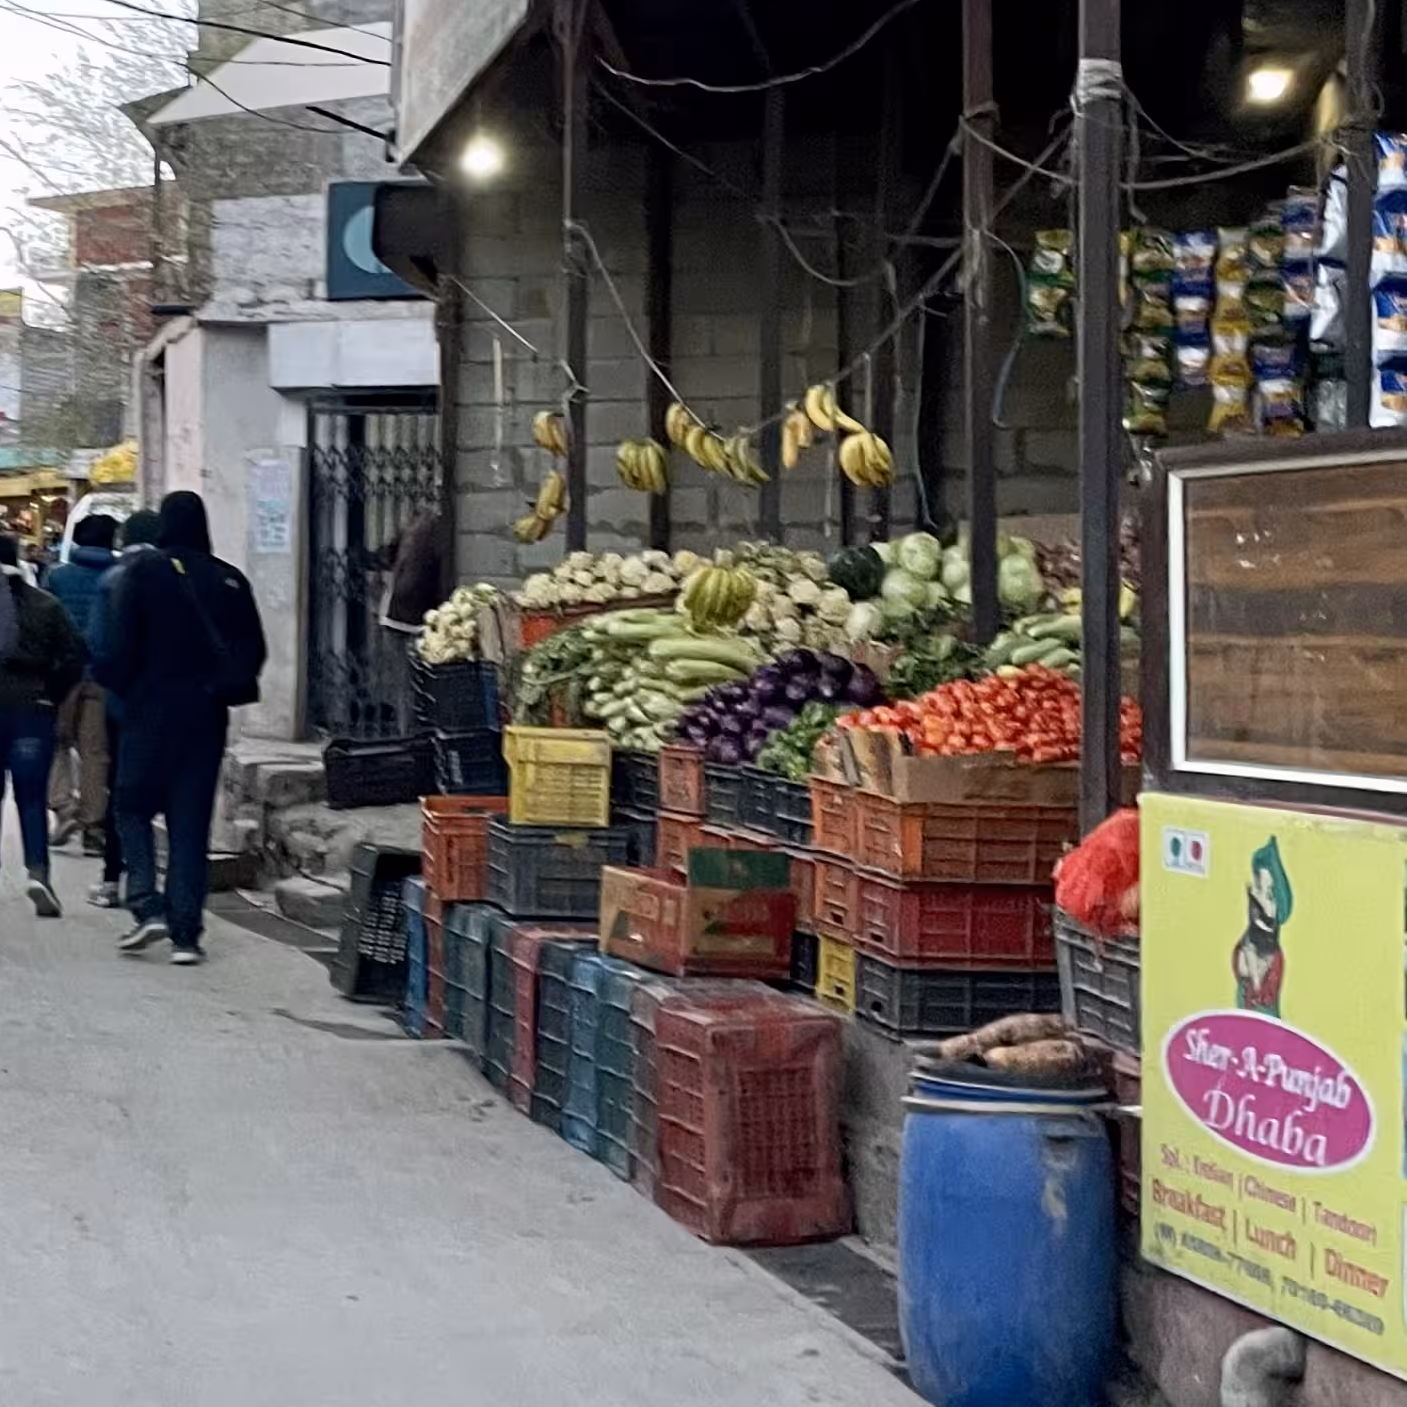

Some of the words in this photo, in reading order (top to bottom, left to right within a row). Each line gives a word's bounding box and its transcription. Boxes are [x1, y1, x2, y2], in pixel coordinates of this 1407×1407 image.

[1202, 1089, 1327, 1165] Dhaba
[1152, 1177, 1227, 1231] Breakfast
[1245, 1217, 1296, 1260] Lunch
[1324, 1246, 1389, 1298] Dinner
